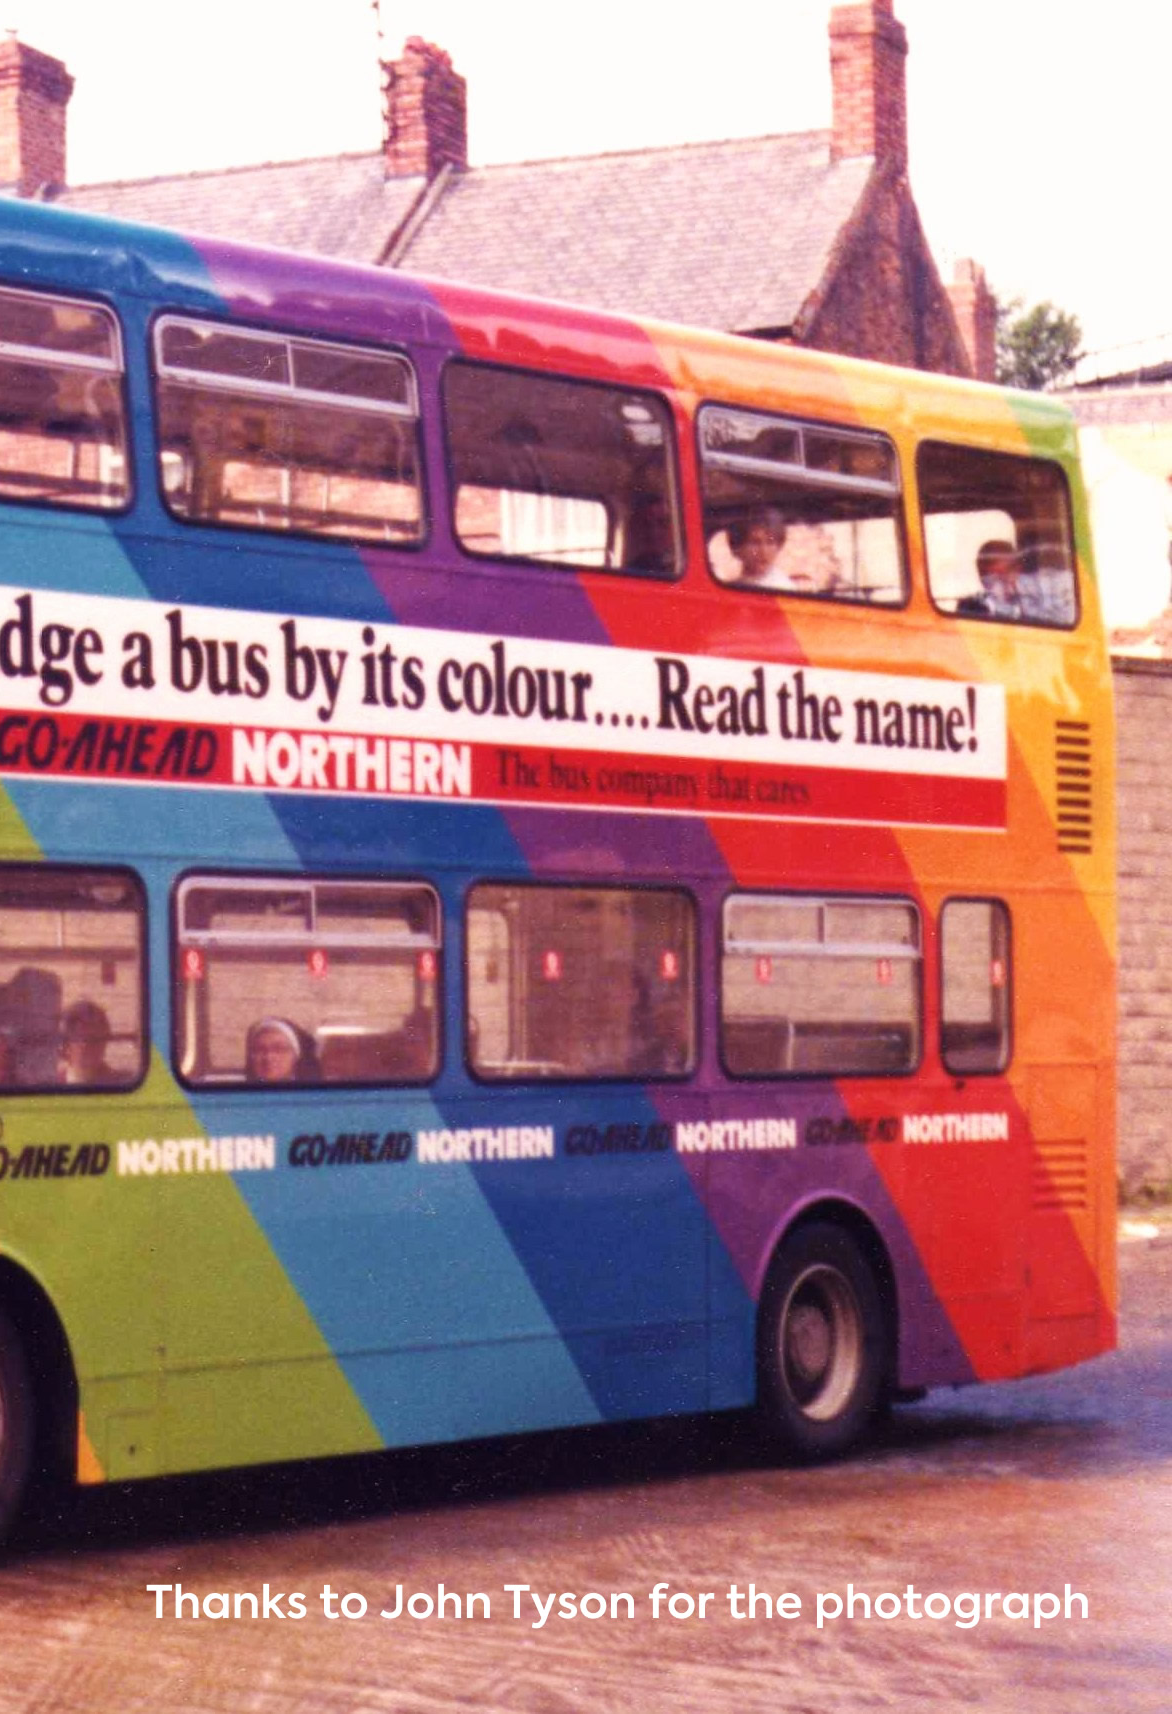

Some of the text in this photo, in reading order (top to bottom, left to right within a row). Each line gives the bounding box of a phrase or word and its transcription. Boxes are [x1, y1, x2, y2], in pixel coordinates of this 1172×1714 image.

[120, 630, 155, 690] a
[164, 609, 270, 699] bus
[282, 619, 348, 723] by
[361, 627, 426, 710] its
[654, 656, 768, 737] Read
[777, 673, 842, 743] the
[854, 684, 979, 753] name!
[231, 730, 472, 797] NORTHERN
[494, 749, 812, 804] The bus company that cares
[117, 1136, 275, 1176] NORTHERN
[416, 1126, 554, 1163] NORTHERN
[676, 1119, 797, 1152] NORTHERN
[903, 1113, 1008, 1143] NORTHERN
